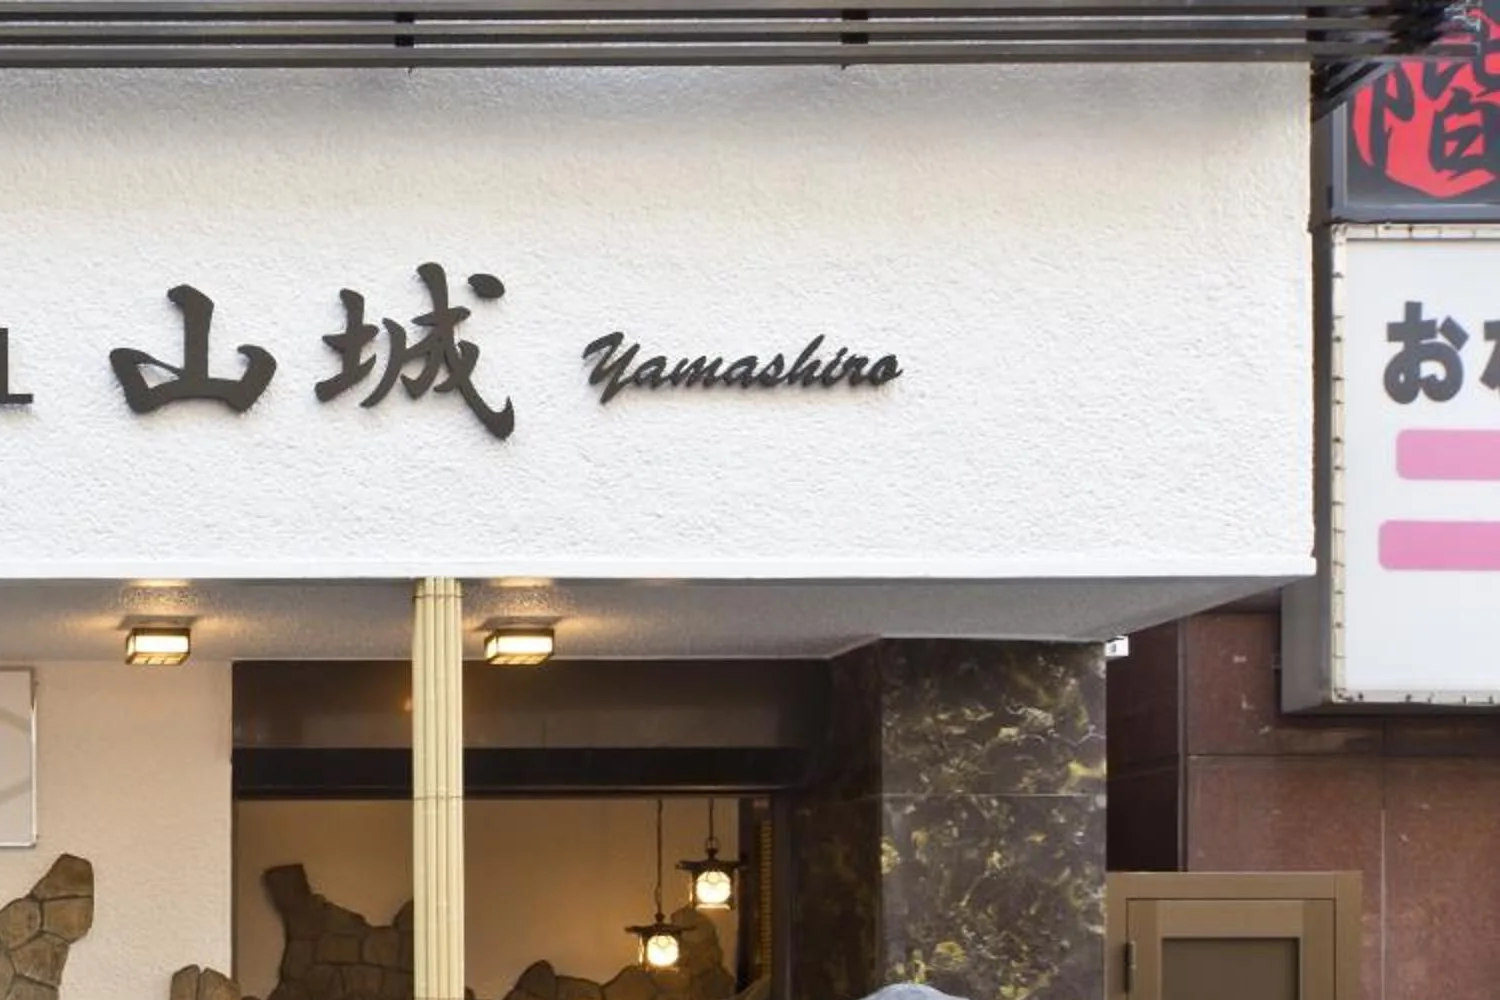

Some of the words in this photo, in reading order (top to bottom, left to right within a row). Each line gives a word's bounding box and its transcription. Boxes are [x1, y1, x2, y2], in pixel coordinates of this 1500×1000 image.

[109, 262, 515, 442] 山城
[583, 331, 903, 405] Yamashiro
[1383, 301, 1500, 404] お
